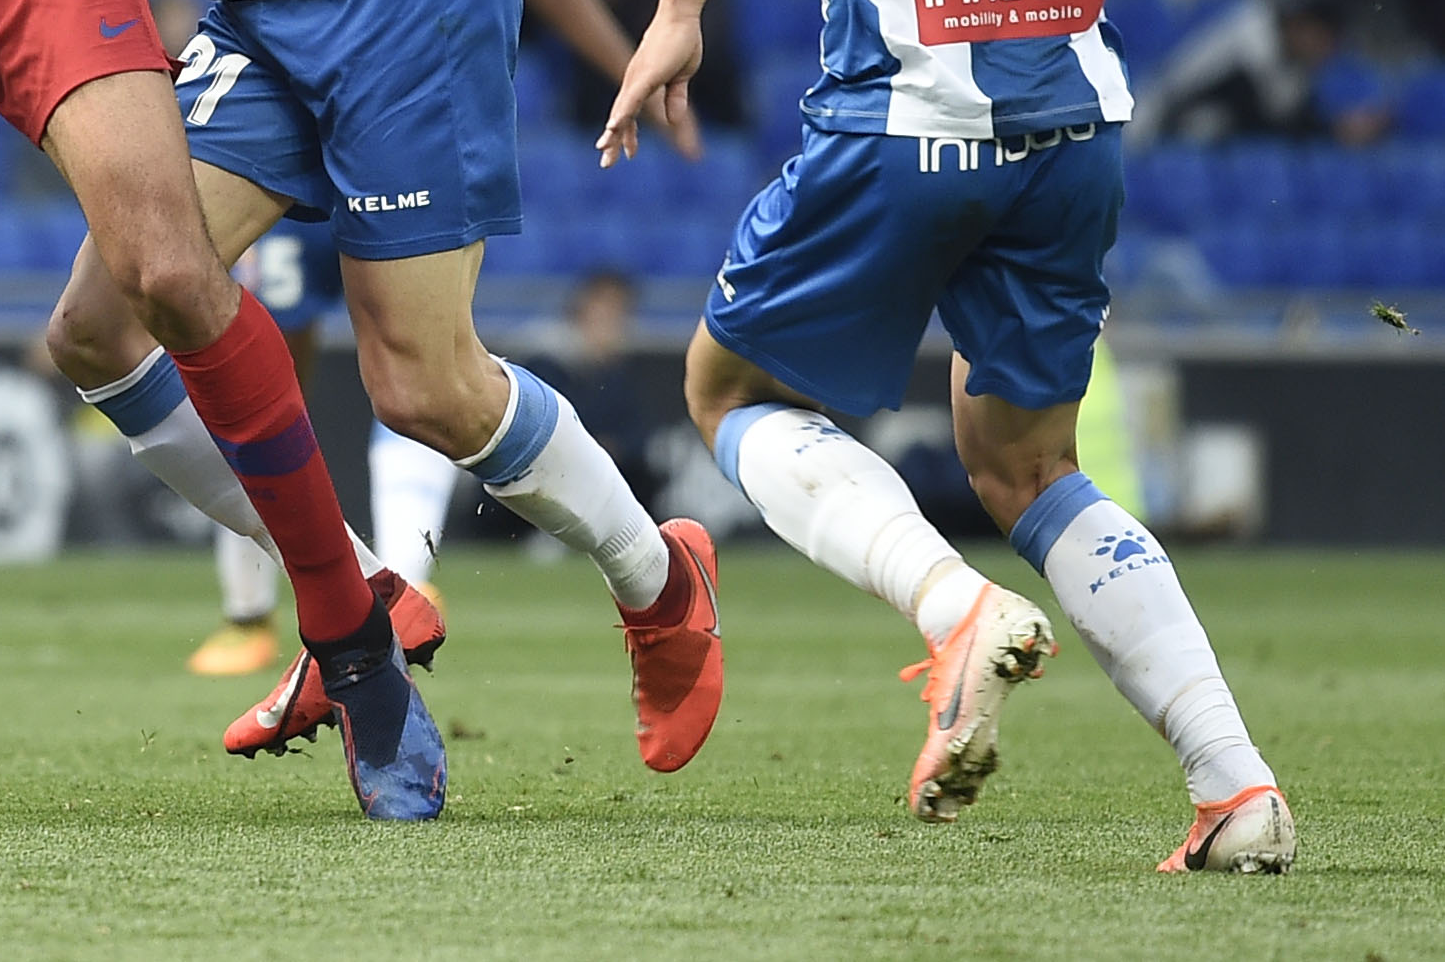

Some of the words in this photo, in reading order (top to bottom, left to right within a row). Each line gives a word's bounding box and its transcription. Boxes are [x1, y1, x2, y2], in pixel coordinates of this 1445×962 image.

[944, 11, 1002, 29] mobility
[1008, 9, 1019, 23] &
[1025, 5, 1083, 22] mobile
[347, 190, 430, 212] KELME
